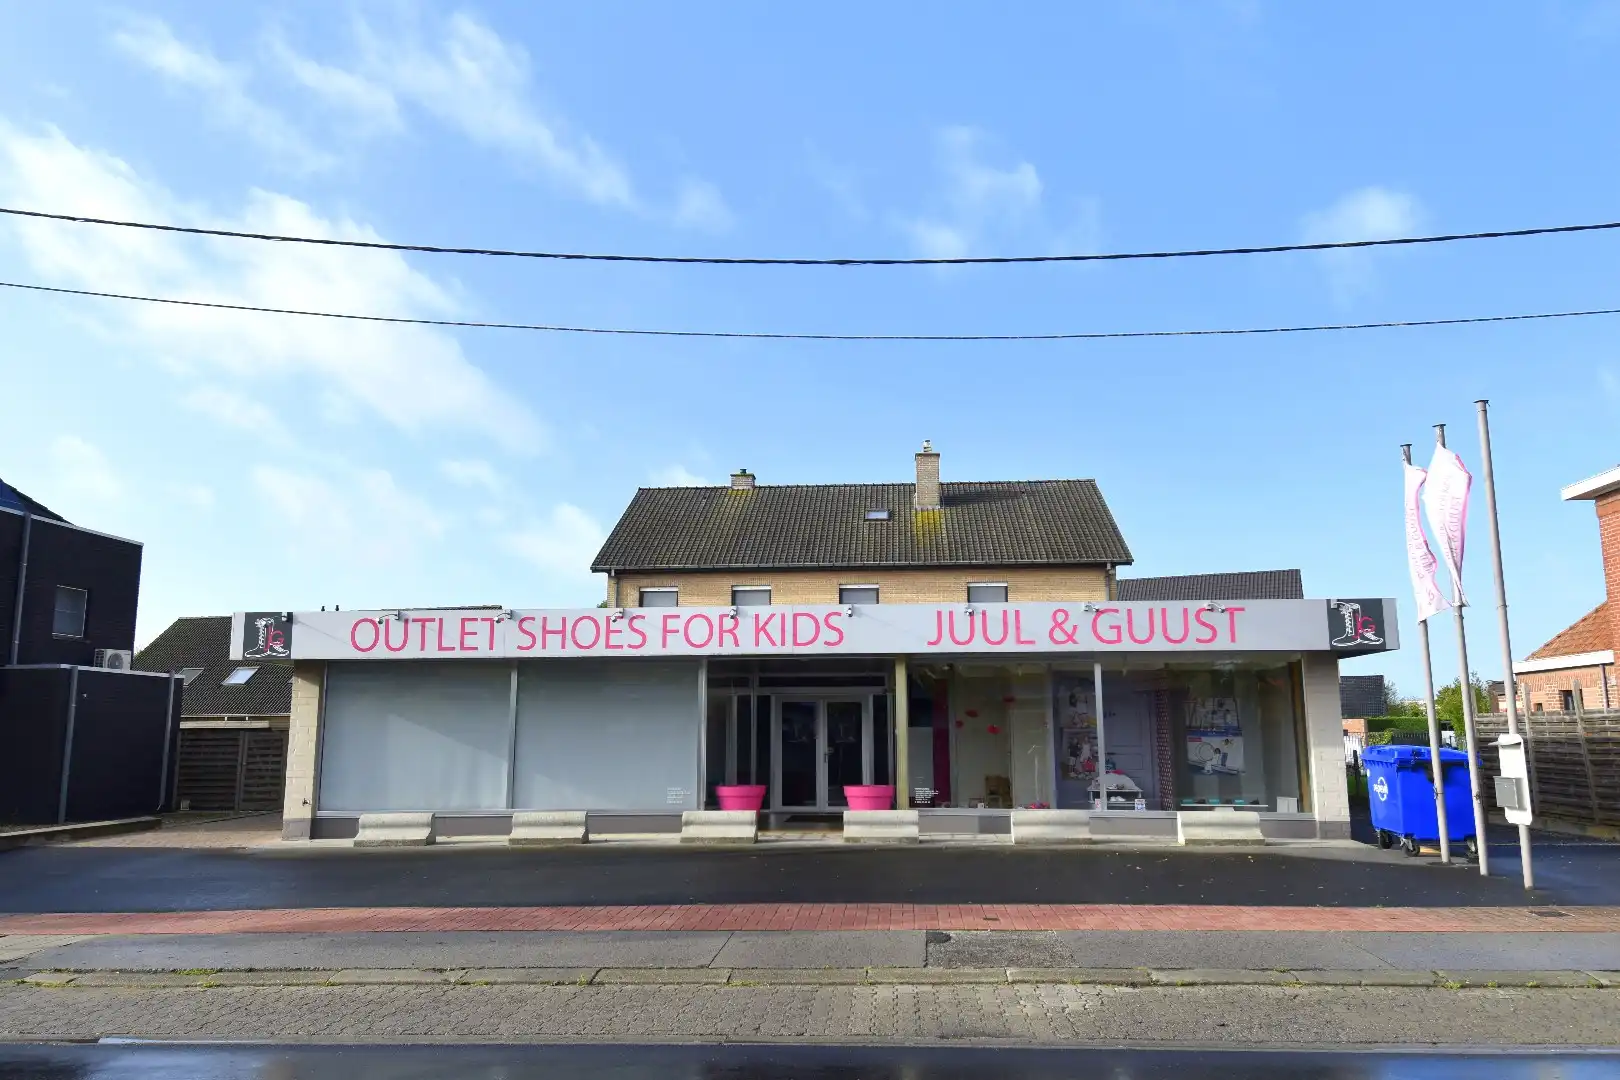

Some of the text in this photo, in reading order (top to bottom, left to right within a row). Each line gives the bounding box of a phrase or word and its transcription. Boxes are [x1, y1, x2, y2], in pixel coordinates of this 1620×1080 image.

[350, 611, 844, 652] OUTLET SHOES FOR KIDS
[927, 606, 1245, 646] JUUL & GUUST
